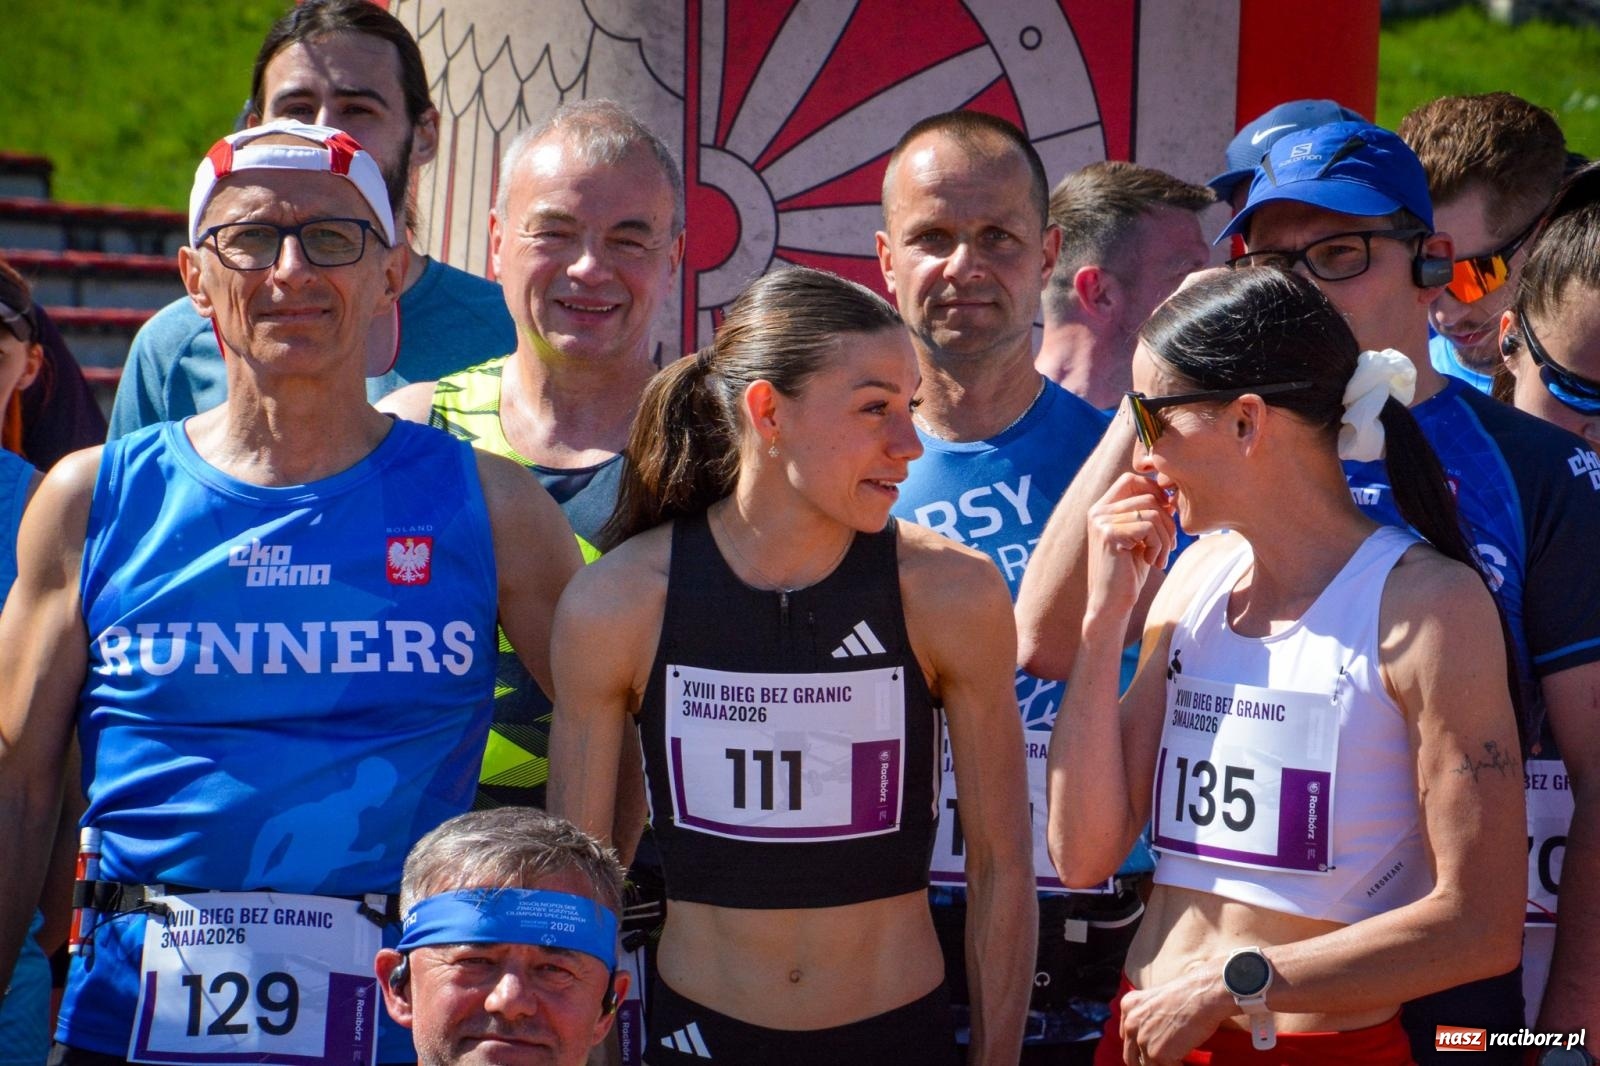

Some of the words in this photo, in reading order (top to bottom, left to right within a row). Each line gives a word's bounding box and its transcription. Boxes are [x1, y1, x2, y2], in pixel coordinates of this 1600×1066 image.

[92, 620, 477, 676] RUNNERS
[683, 680, 715, 700] XVIII
[720, 685, 755, 703] BIEG
[760, 687, 788, 704] BEZ
[793, 686, 852, 704] GRANIC
[1176, 689, 1193, 707] XVIII
[1192, 692, 1212, 712] BIEG
[1214, 697, 1233, 716] BEZ
[1236, 700, 1286, 722] GRANIC
[682, 699, 767, 723] 3MAJA2026
[1172, 709, 1219, 734] 3MAJA2026
[725, 748, 802, 811] 111
[1175, 756, 1256, 832] 135
[1307, 796, 1318, 840] Racibórz
[163, 909, 195, 928] XVIII
[199, 908, 234, 925] BIEG
[240, 908, 268, 925] BEZ
[274, 908, 333, 929] GRANIC
[549, 921, 576, 933] 2020
[161, 927, 246, 949] 3MAJA2026
[181, 971, 299, 1037] 129
